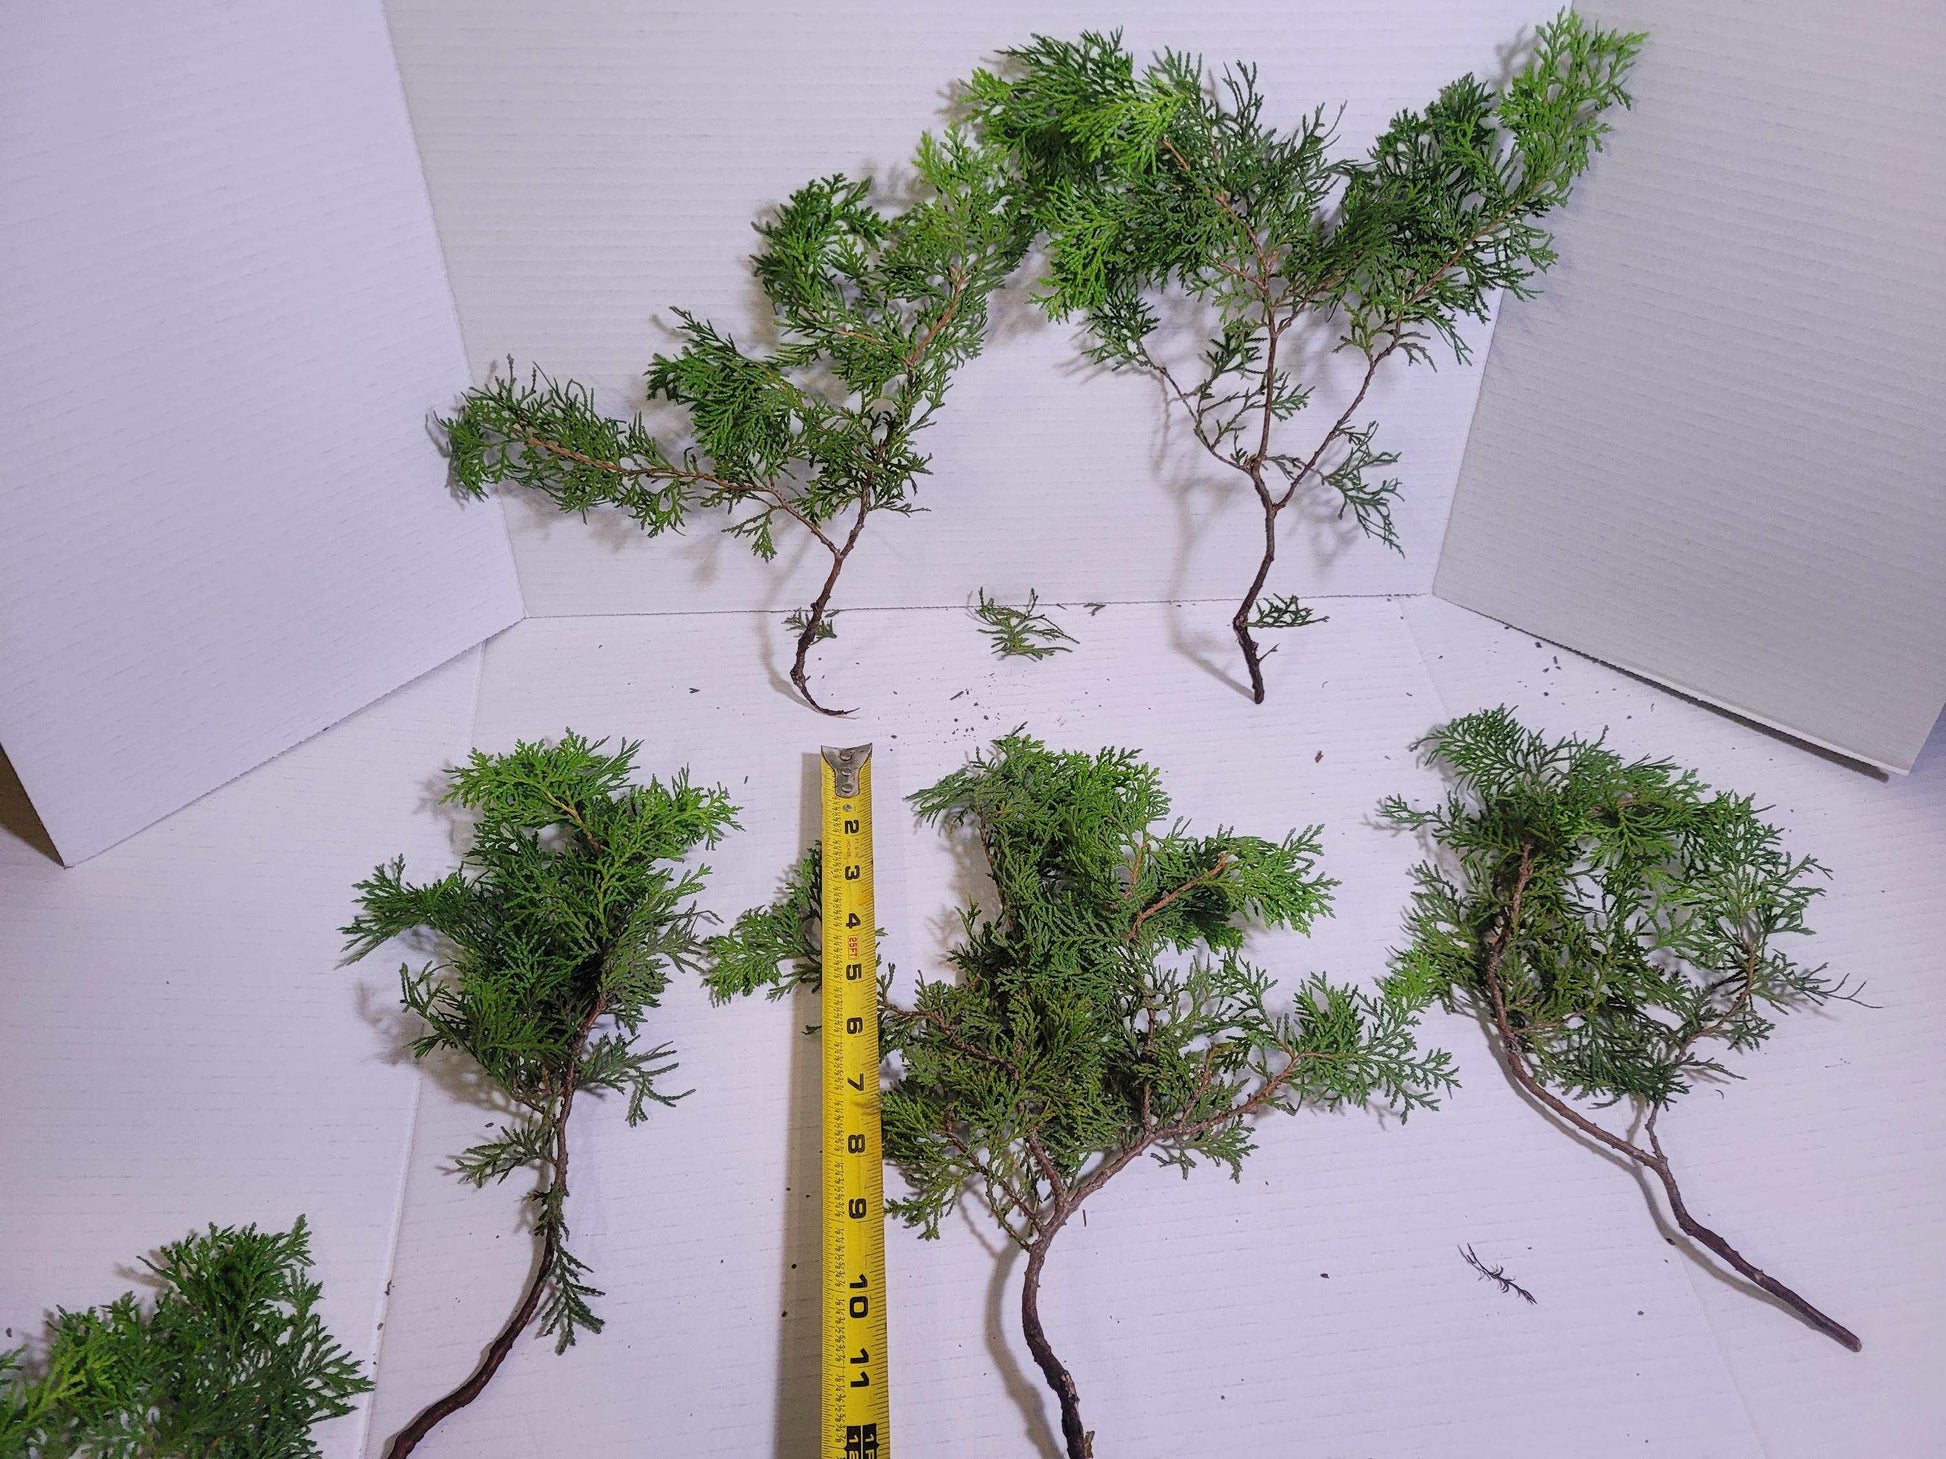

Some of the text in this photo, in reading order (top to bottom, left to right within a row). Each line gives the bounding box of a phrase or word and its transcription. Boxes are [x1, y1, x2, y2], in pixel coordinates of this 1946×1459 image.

[845, 820, 859, 834] 2
[845, 865, 860, 880] 3
[846, 913, 861, 928] 4
[849, 937, 858, 957] 25FT
[846, 964, 862, 980] 5
[847, 1018, 863, 1034] 6
[848, 1074, 864, 1091] 7
[848, 1134, 865, 1153] 8
[849, 1198, 867, 1219] 9
[850, 1274, 869, 1318] 10
[850, 1348, 869, 1388] 11
